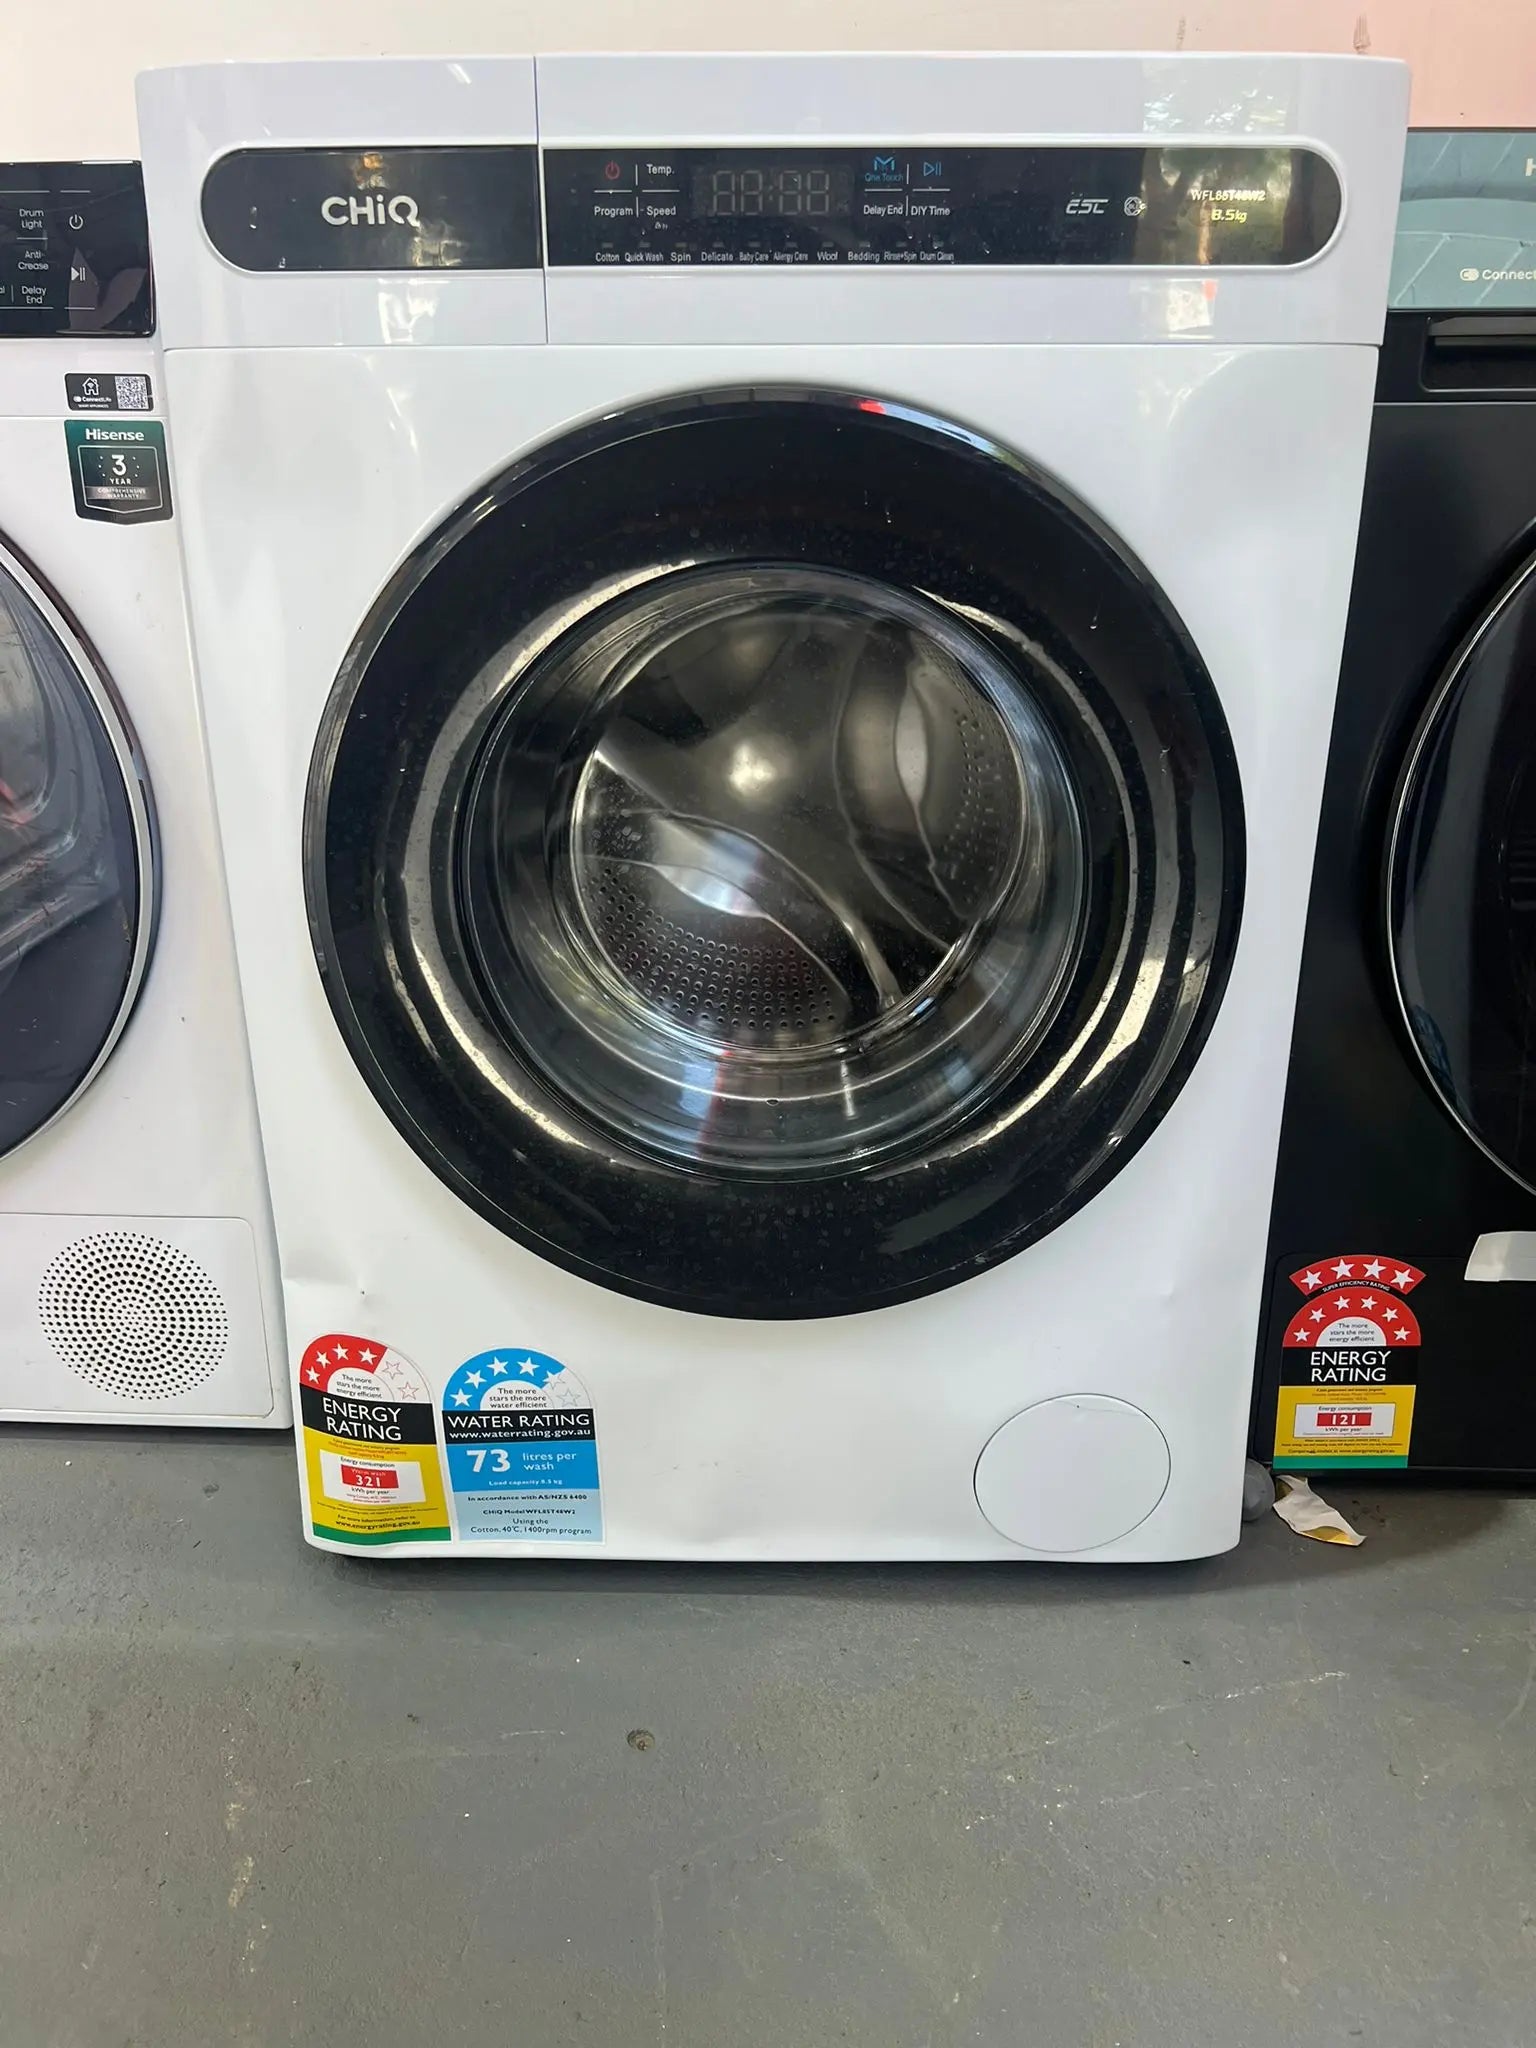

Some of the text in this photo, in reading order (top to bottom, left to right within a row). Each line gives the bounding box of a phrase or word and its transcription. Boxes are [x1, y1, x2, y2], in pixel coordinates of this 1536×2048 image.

[646, 164, 675, 177] Temp.
[864, 172, 904, 182] One Touch
[19, 209, 44, 217] Drum
[321, 194, 420, 227] CHiQ
[594, 206, 633, 217] Program
[646, 205, 677, 218] Speed
[863, 204, 903, 217] Delay End
[911, 205, 951, 216] DIY Time
[1211, 208, 1248, 223] 8.5kg
[21, 220, 43, 230] Light
[595, 252, 620, 262] Cotton
[624, 252, 664, 263] Quick Wash
[670, 252, 692, 263] Spin
[701, 252, 733, 261] Delicate
[739, 252, 769, 263] Baby Care
[773, 252, 794, 263] Allergy
[817, 251, 839, 261] Wool
[847, 251, 880, 263] Bedding
[919, 252, 955, 261] Drum Clean
[18, 262, 49, 270] Crease
[21, 286, 47, 296] Delay
[26, 295, 43, 304] End
[85, 428, 145, 441] Hisense
[111, 454, 127, 476] 3
[1322, 1283, 1338, 1292] SUPER
[1369, 1281, 1390, 1291] RATING
[1310, 1351, 1391, 1366] ENERGY
[1311, 1367, 1386, 1382] RATING
[336, 1388, 356, 1396] energy
[323, 1397, 402, 1422] ENERGY
[447, 1414, 590, 1428] WATER RATING
[1332, 1414, 1356, 1425] 121
[326, 1416, 402, 1441] RATING
[449, 1428, 591, 1439] www.waterrating.gov.au
[341, 1457, 358, 1465] Energy
[466, 1449, 511, 1473] 73
[522, 1452, 577, 1463] litres per
[523, 1462, 554, 1470] wash
[355, 1474, 381, 1487] 321
[336, 1520, 421, 1530] www.energyrating.gov.au
[524, 1526, 557, 1534] 1400rpm
[559, 1528, 592, 1536] program
